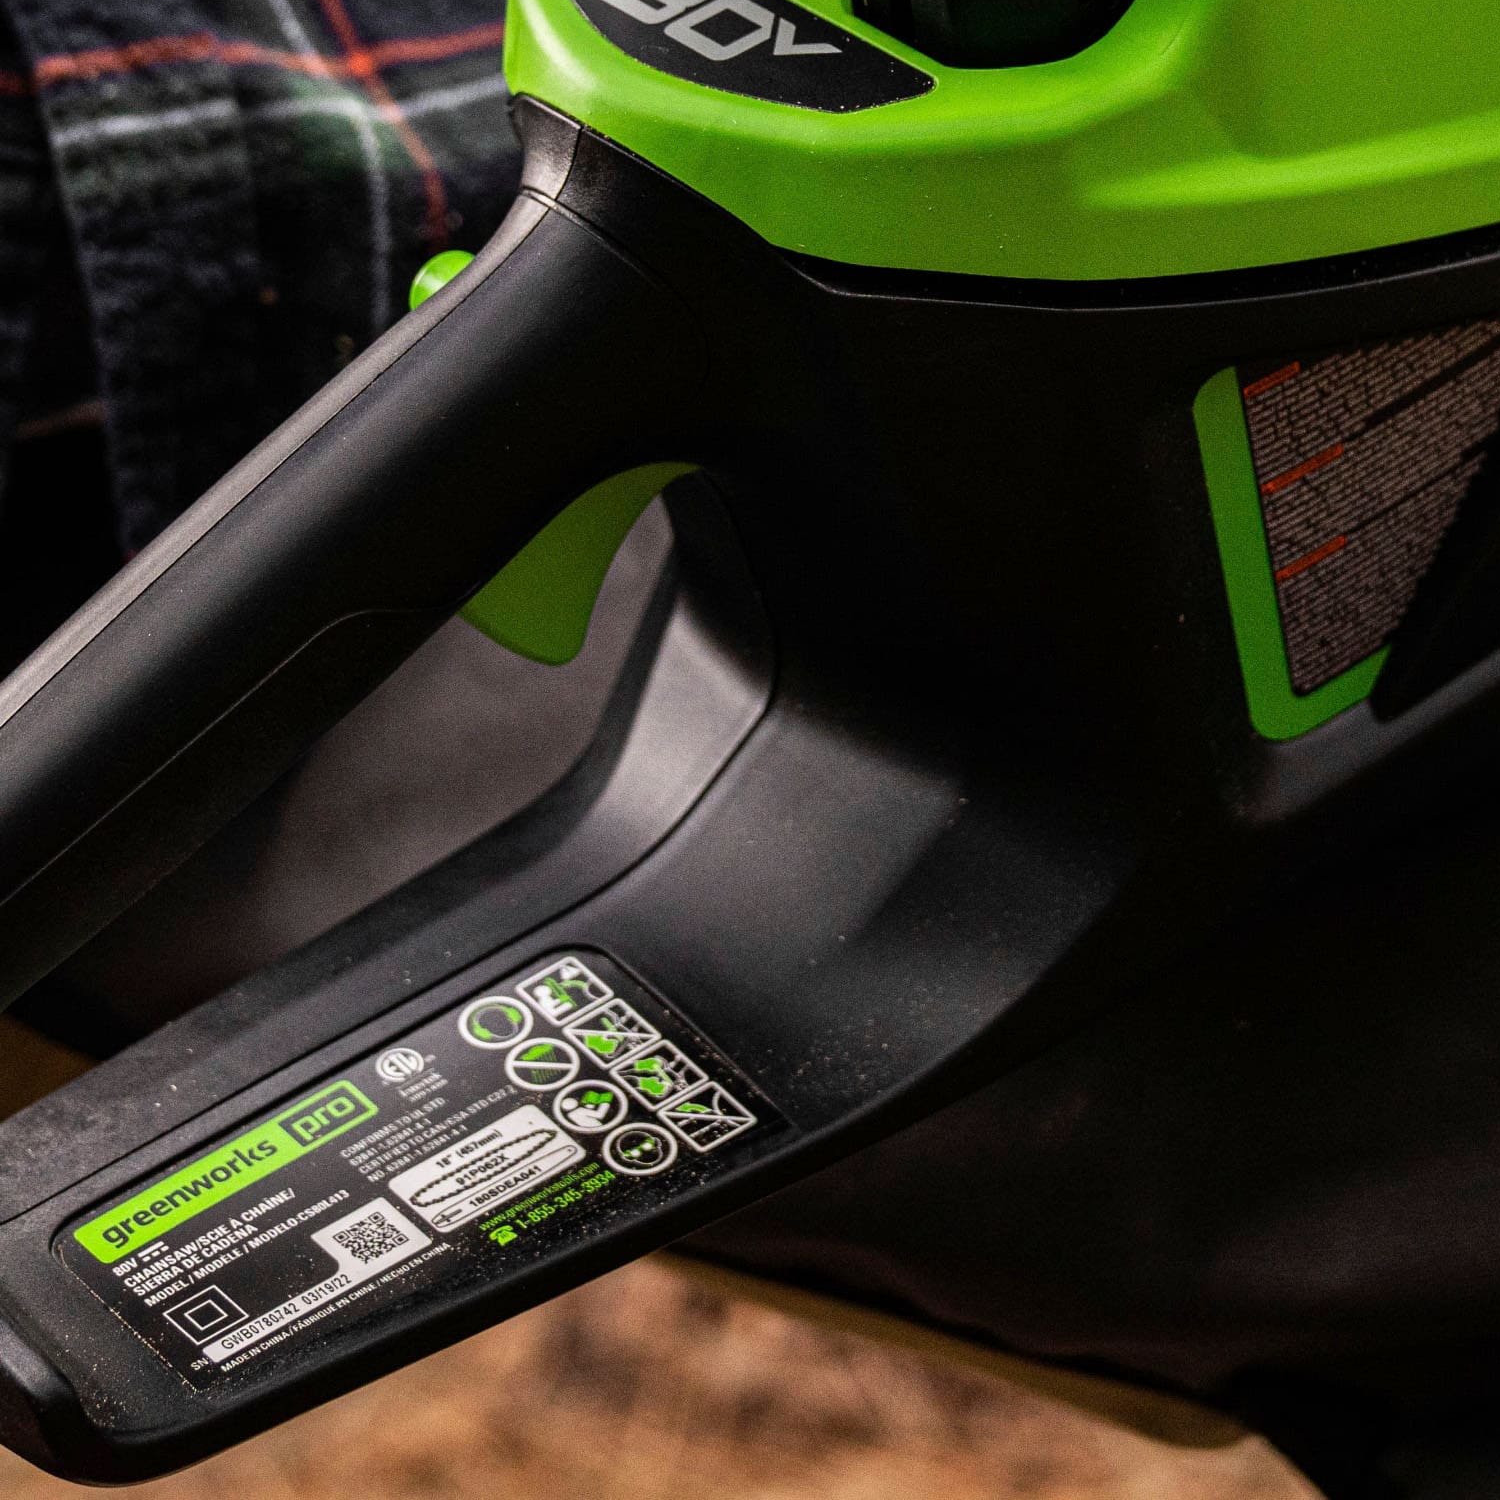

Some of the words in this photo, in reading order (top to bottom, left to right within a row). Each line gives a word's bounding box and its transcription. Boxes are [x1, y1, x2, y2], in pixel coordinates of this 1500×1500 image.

[102, 1140, 279, 1249] greenworks
[291, 1095, 356, 1141] pro
[455, 1153, 510, 1186] 91P062X
[469, 1165, 543, 1208] 180SDEA041
[515, 1169, 616, 1229] 1-855-345-3934
[112, 1257, 139, 1278] 80V
[124, 1221, 230, 1289] CHAINSAW/SCIE
[133, 1265, 184, 1297] SIERRA
[182, 1254, 204, 1271] DE
[201, 1224, 259, 1259] CADENA
[144, 1281, 191, 1308] MODEL
[302, 1273, 353, 1306] 03/19/22
[220, 1353, 250, 1373] MADE
